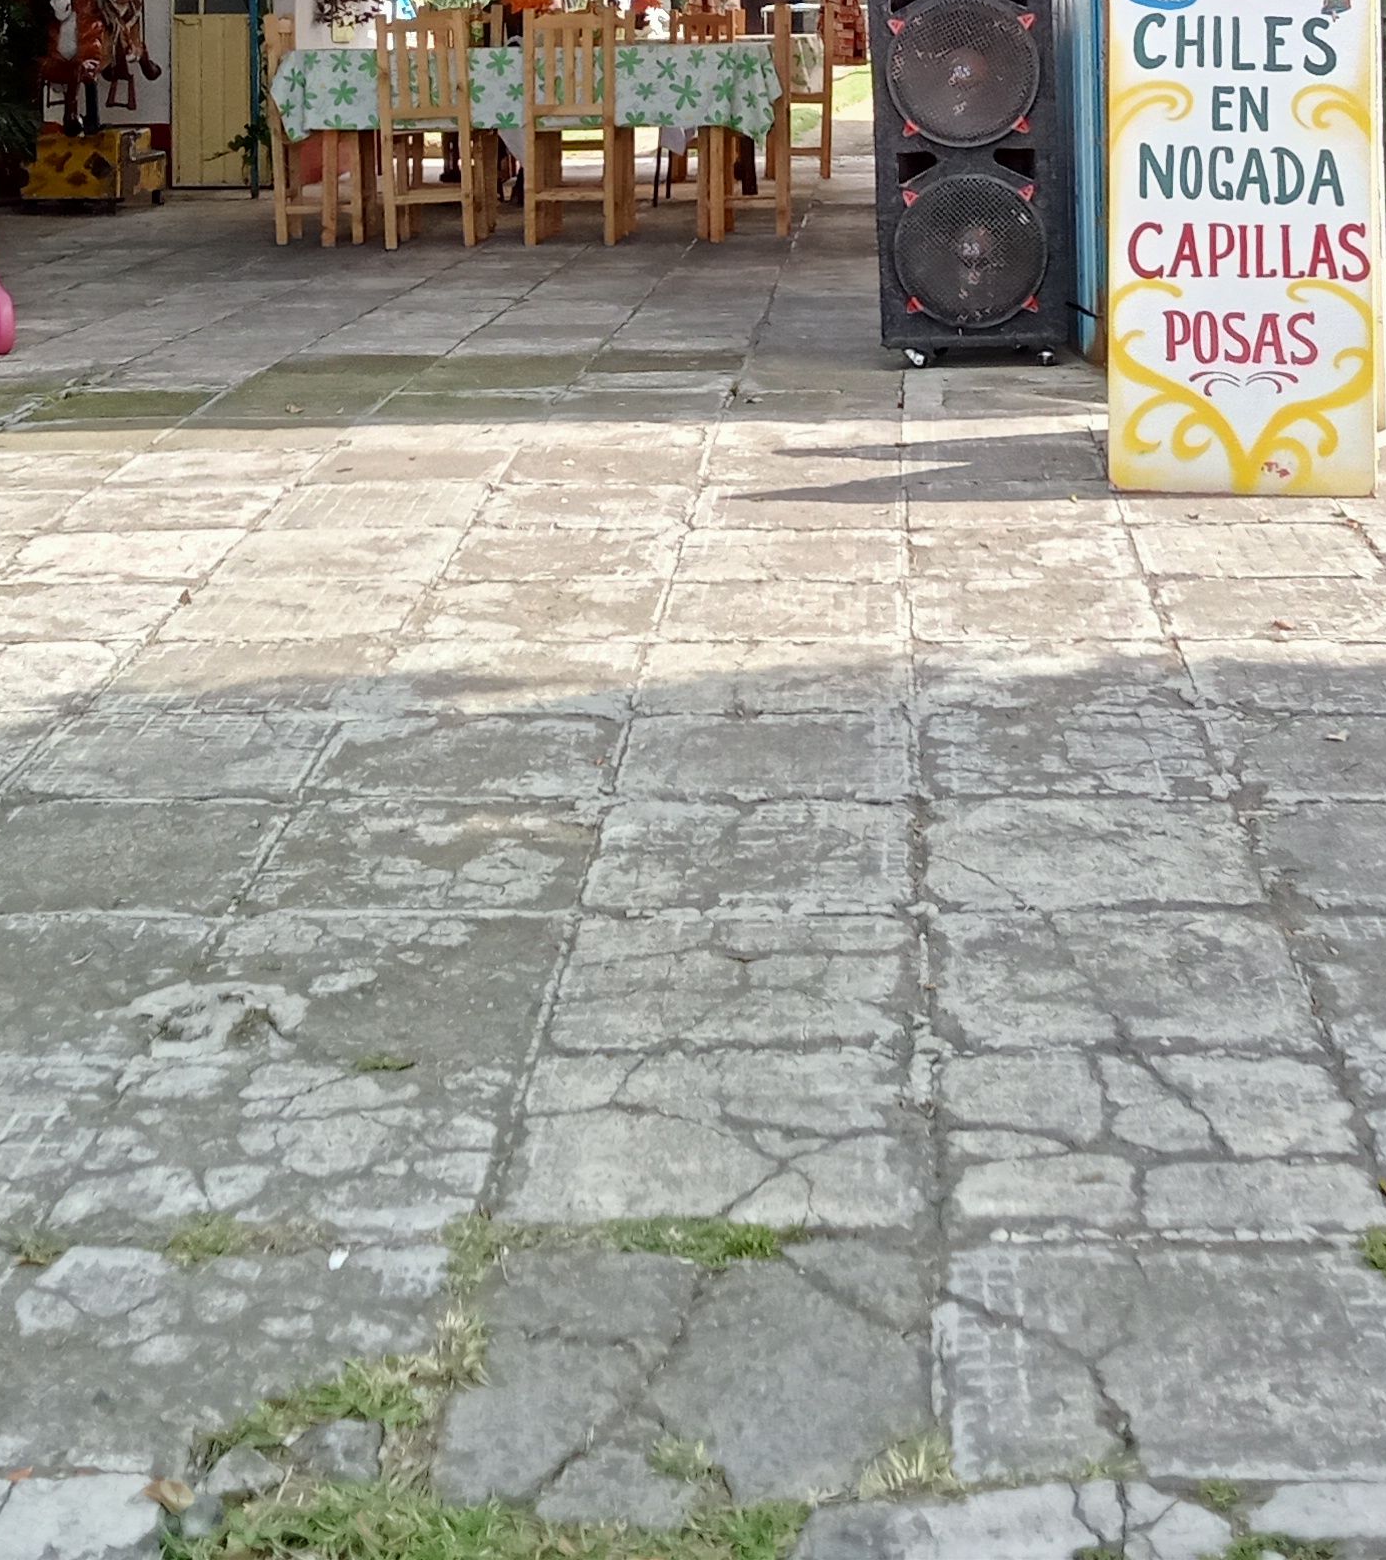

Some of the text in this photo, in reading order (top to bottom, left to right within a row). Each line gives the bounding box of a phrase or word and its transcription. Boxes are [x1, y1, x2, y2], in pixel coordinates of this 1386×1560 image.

[1134, 13, 1336, 75] CHILES
[1212, 86, 1268, 132] EN
[1140, 143, 1344, 206] NOGADA
[1128, 222, 1370, 282] CAPILLAS
[1163, 311, 1318, 365] POSAS
